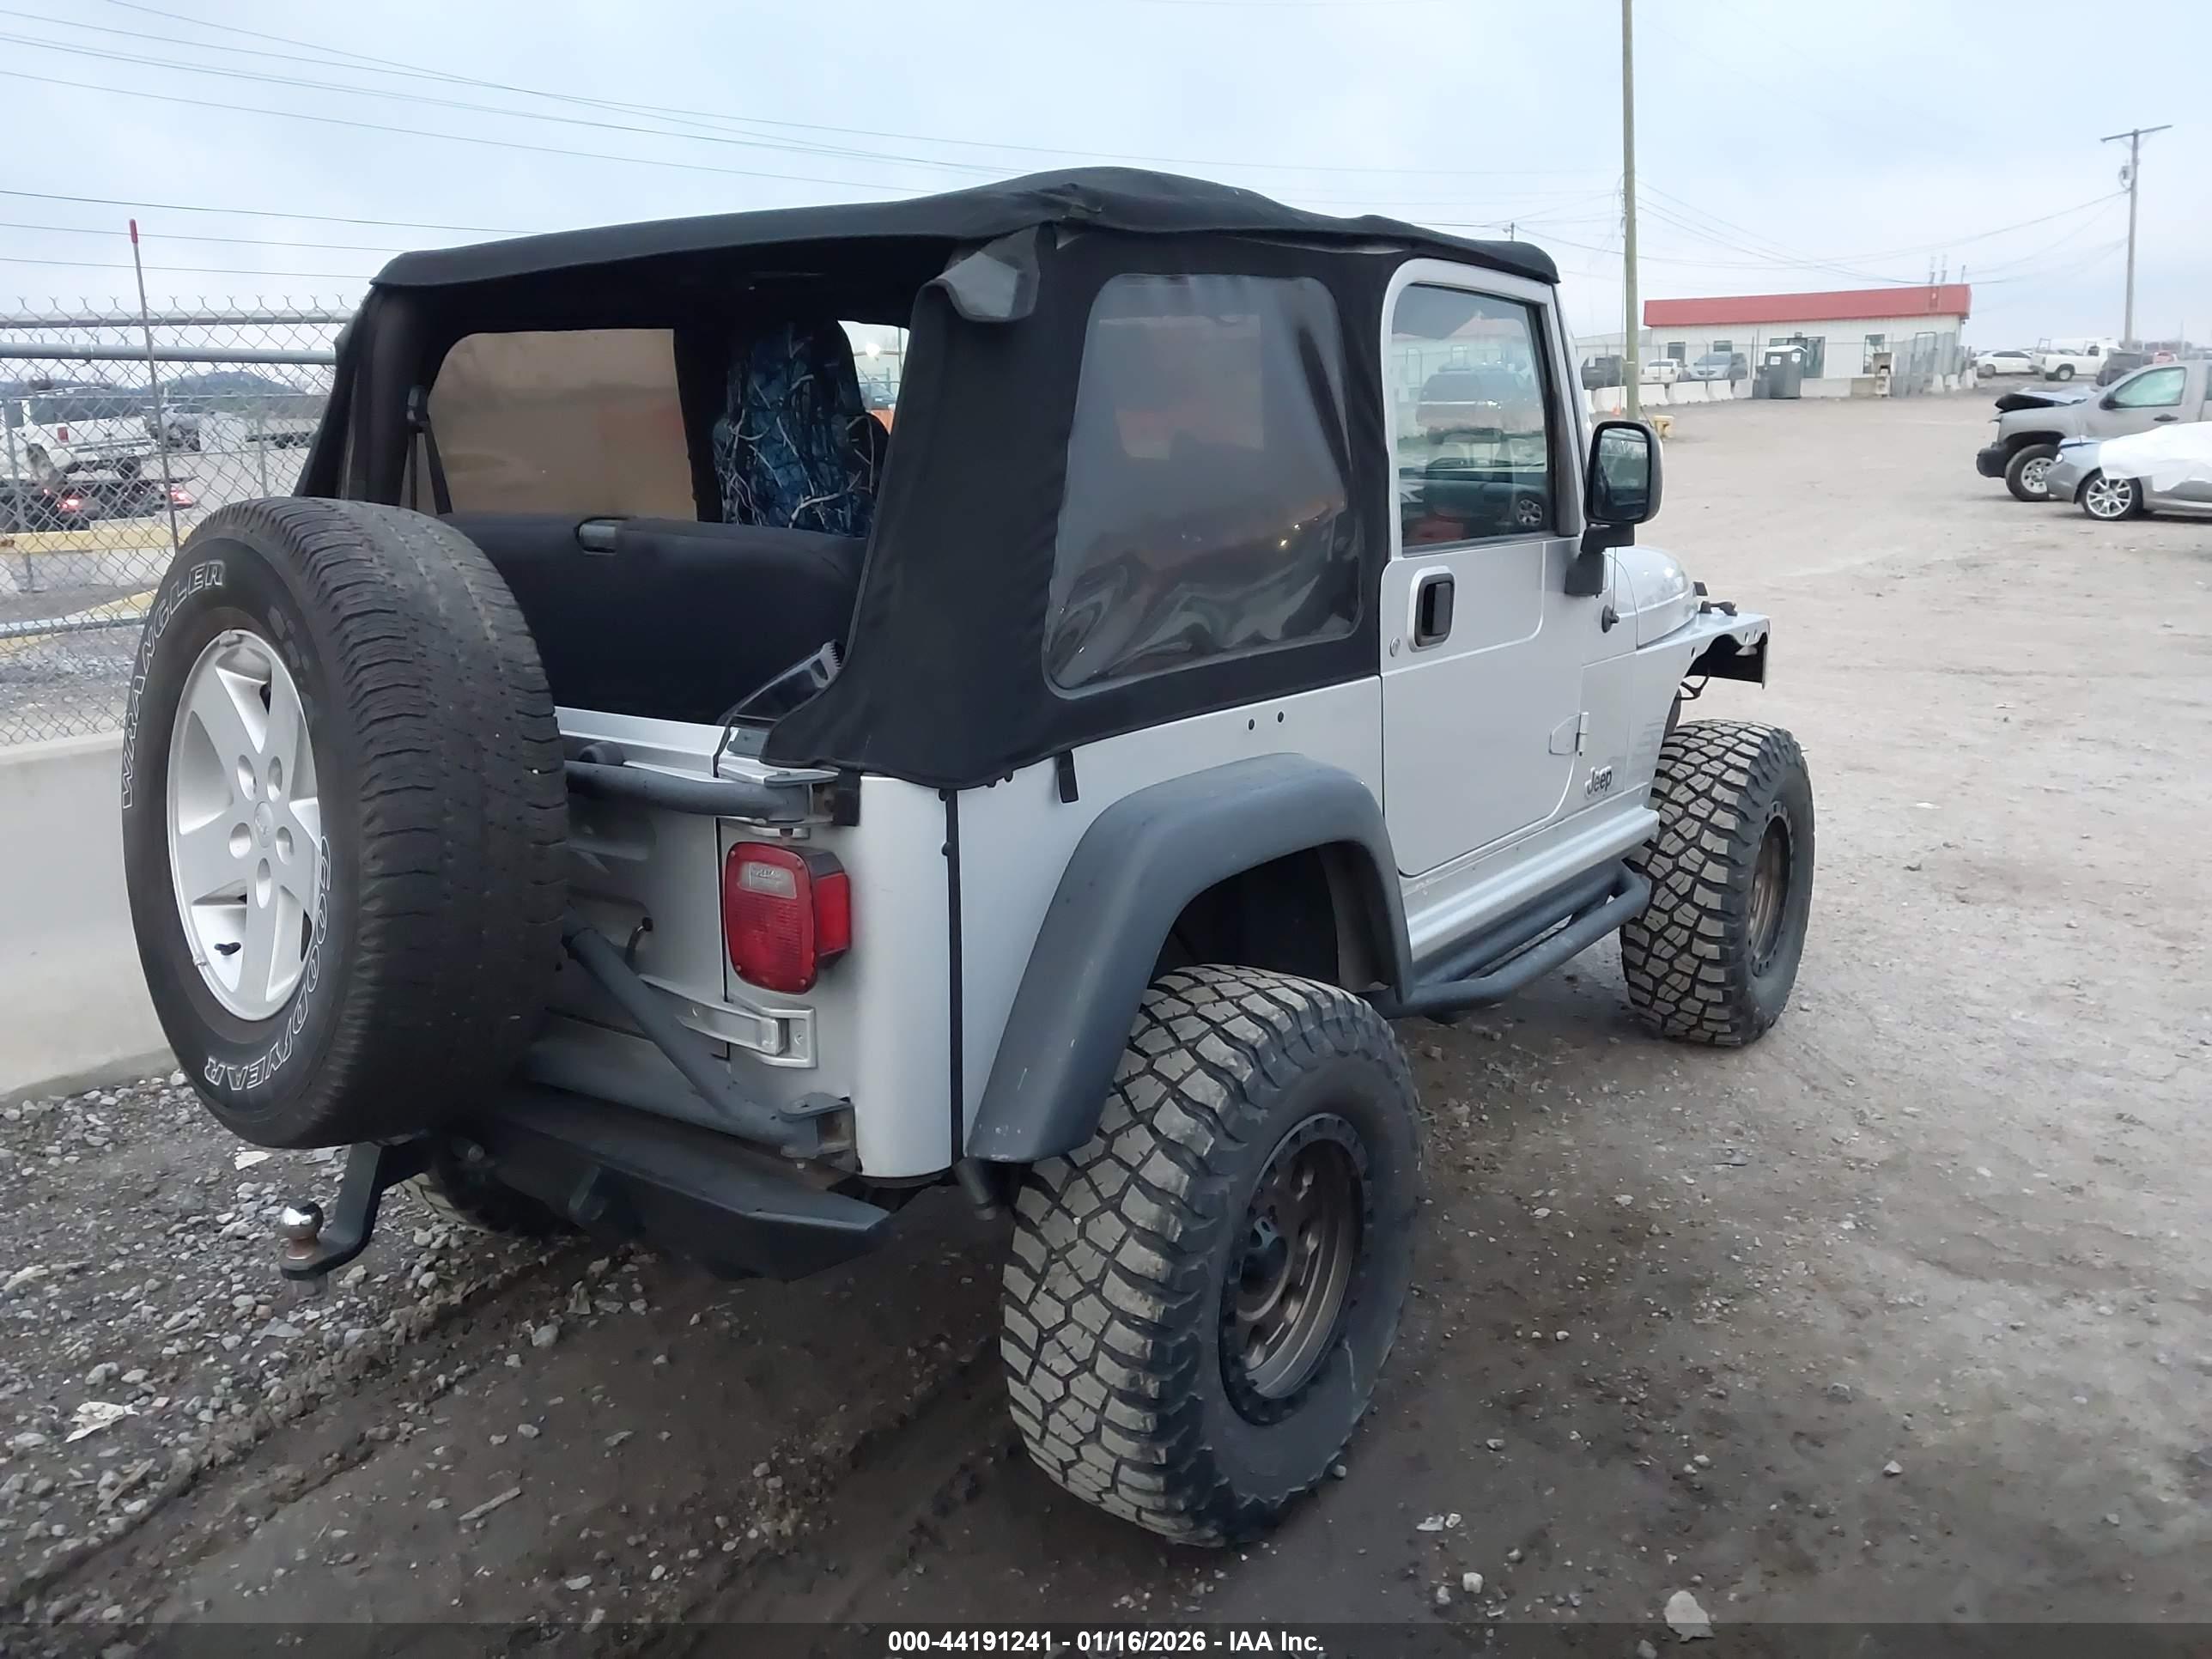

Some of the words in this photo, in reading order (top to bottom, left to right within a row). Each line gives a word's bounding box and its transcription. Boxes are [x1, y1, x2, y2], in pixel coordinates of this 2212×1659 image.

[121, 560, 225, 809] WRANGLER
[1584, 766, 1613, 795] Jeep
[204, 836, 331, 1091] GOODYEAR
